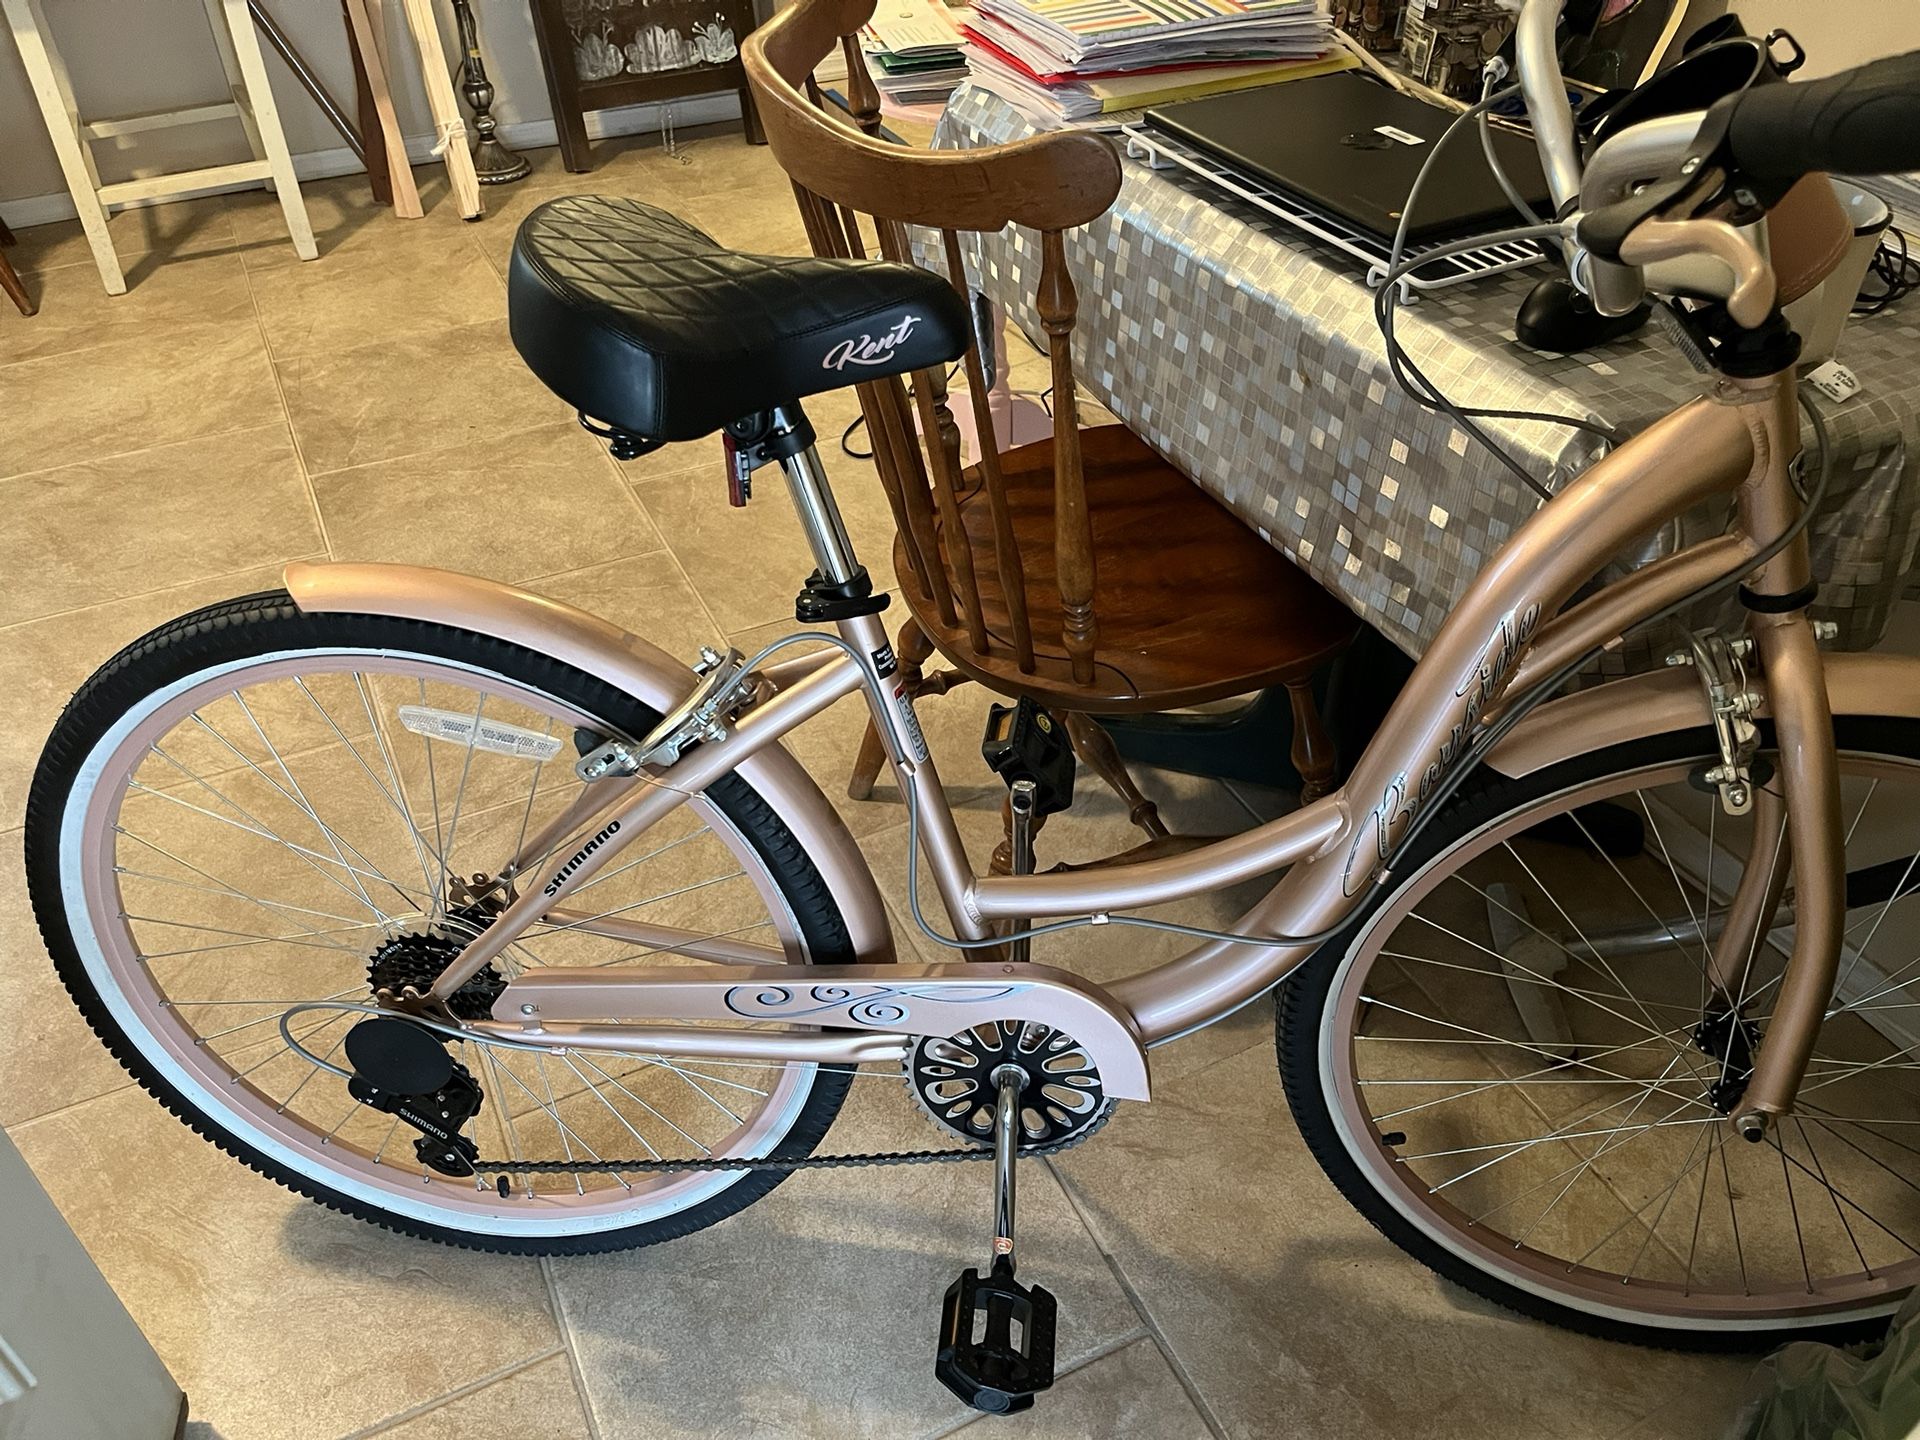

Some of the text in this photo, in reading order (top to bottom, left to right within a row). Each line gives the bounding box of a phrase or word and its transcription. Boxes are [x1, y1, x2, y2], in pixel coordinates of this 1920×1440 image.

[822, 315, 921, 371] Kent
[544, 820, 621, 897] SHIMANO
[399, 1107, 448, 1140] SHIMANO
